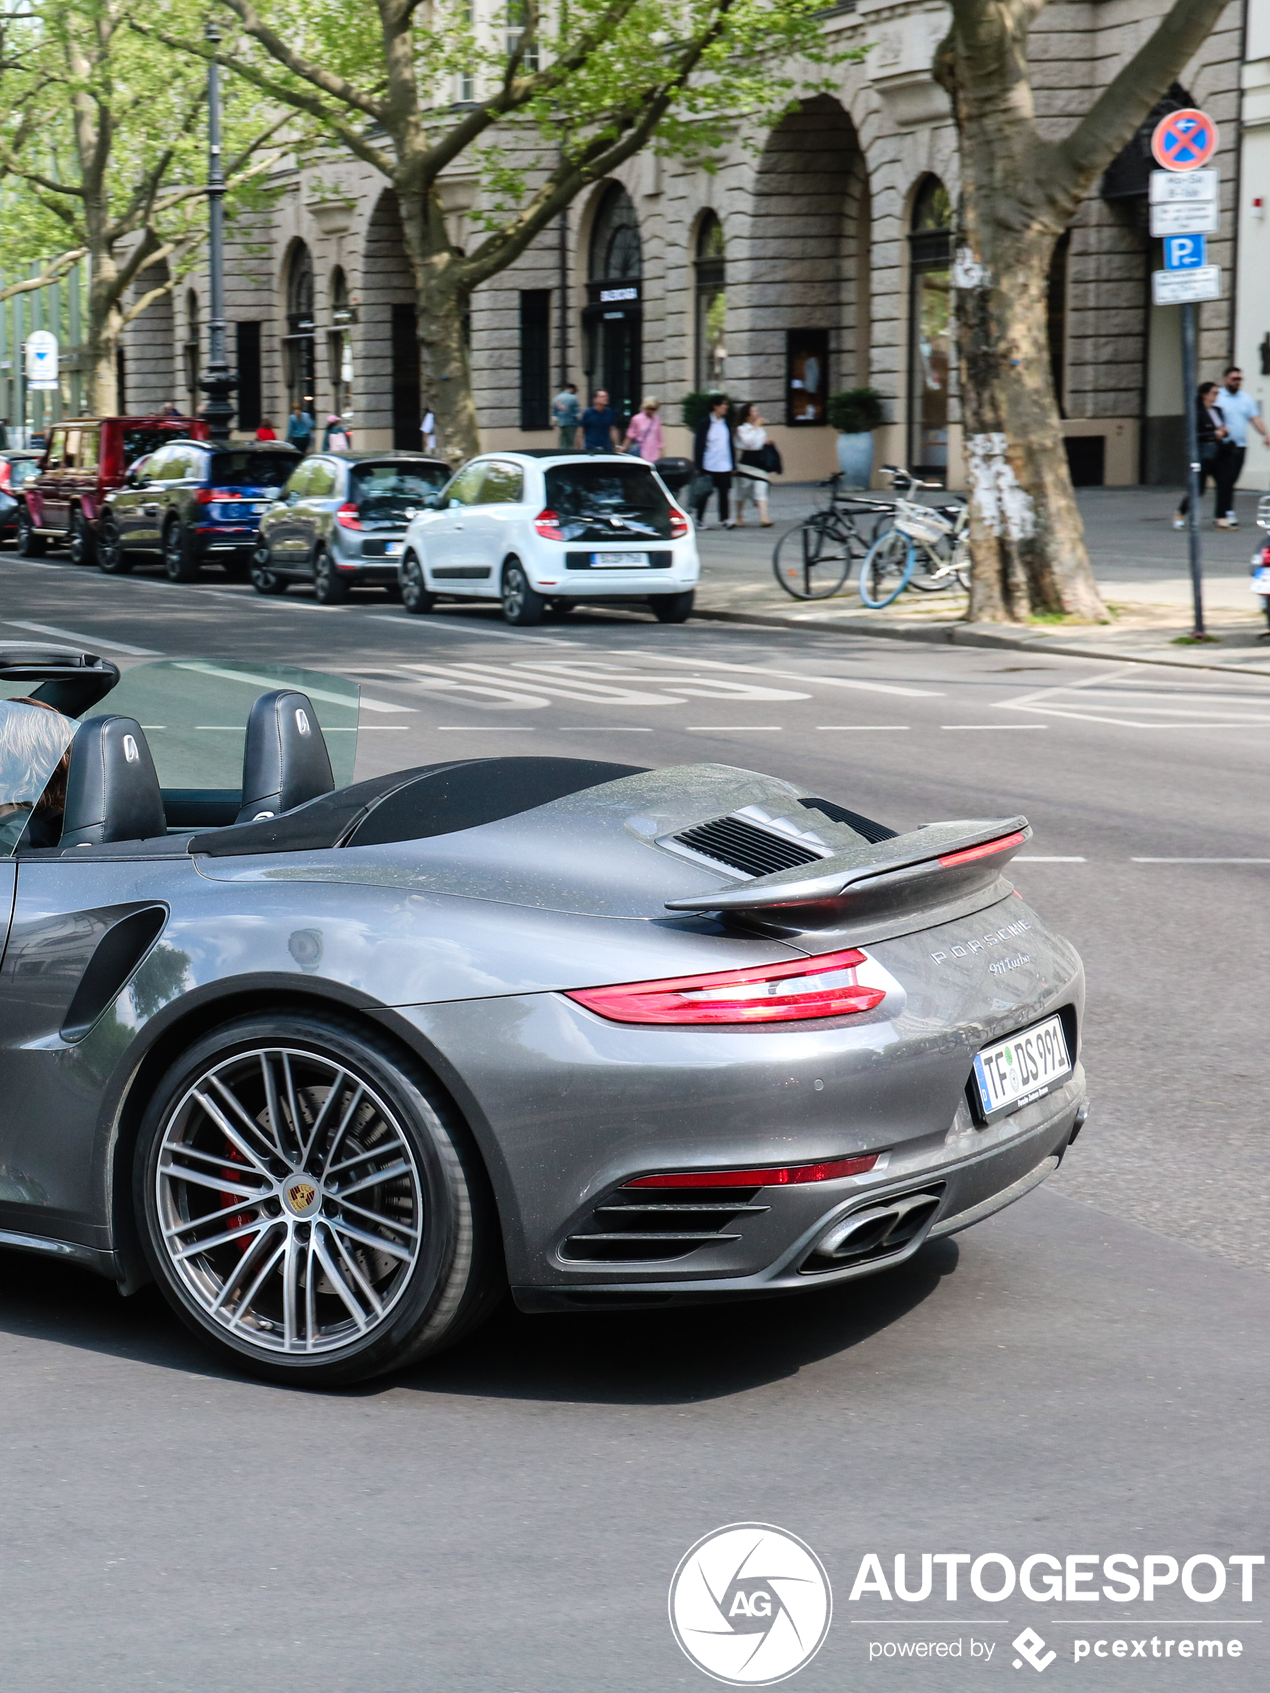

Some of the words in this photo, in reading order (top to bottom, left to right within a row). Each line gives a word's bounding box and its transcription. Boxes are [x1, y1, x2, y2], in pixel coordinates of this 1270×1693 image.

[1170, 238, 1194, 267] P
[334, 660, 814, 711] BUS
[930, 919, 1032, 966] PORSCHE
[989, 959, 1007, 976] 911
[983, 1051, 1008, 1100] TF
[1013, 1038, 1039, 1087] DS
[1036, 1025, 1066, 1075] 991
